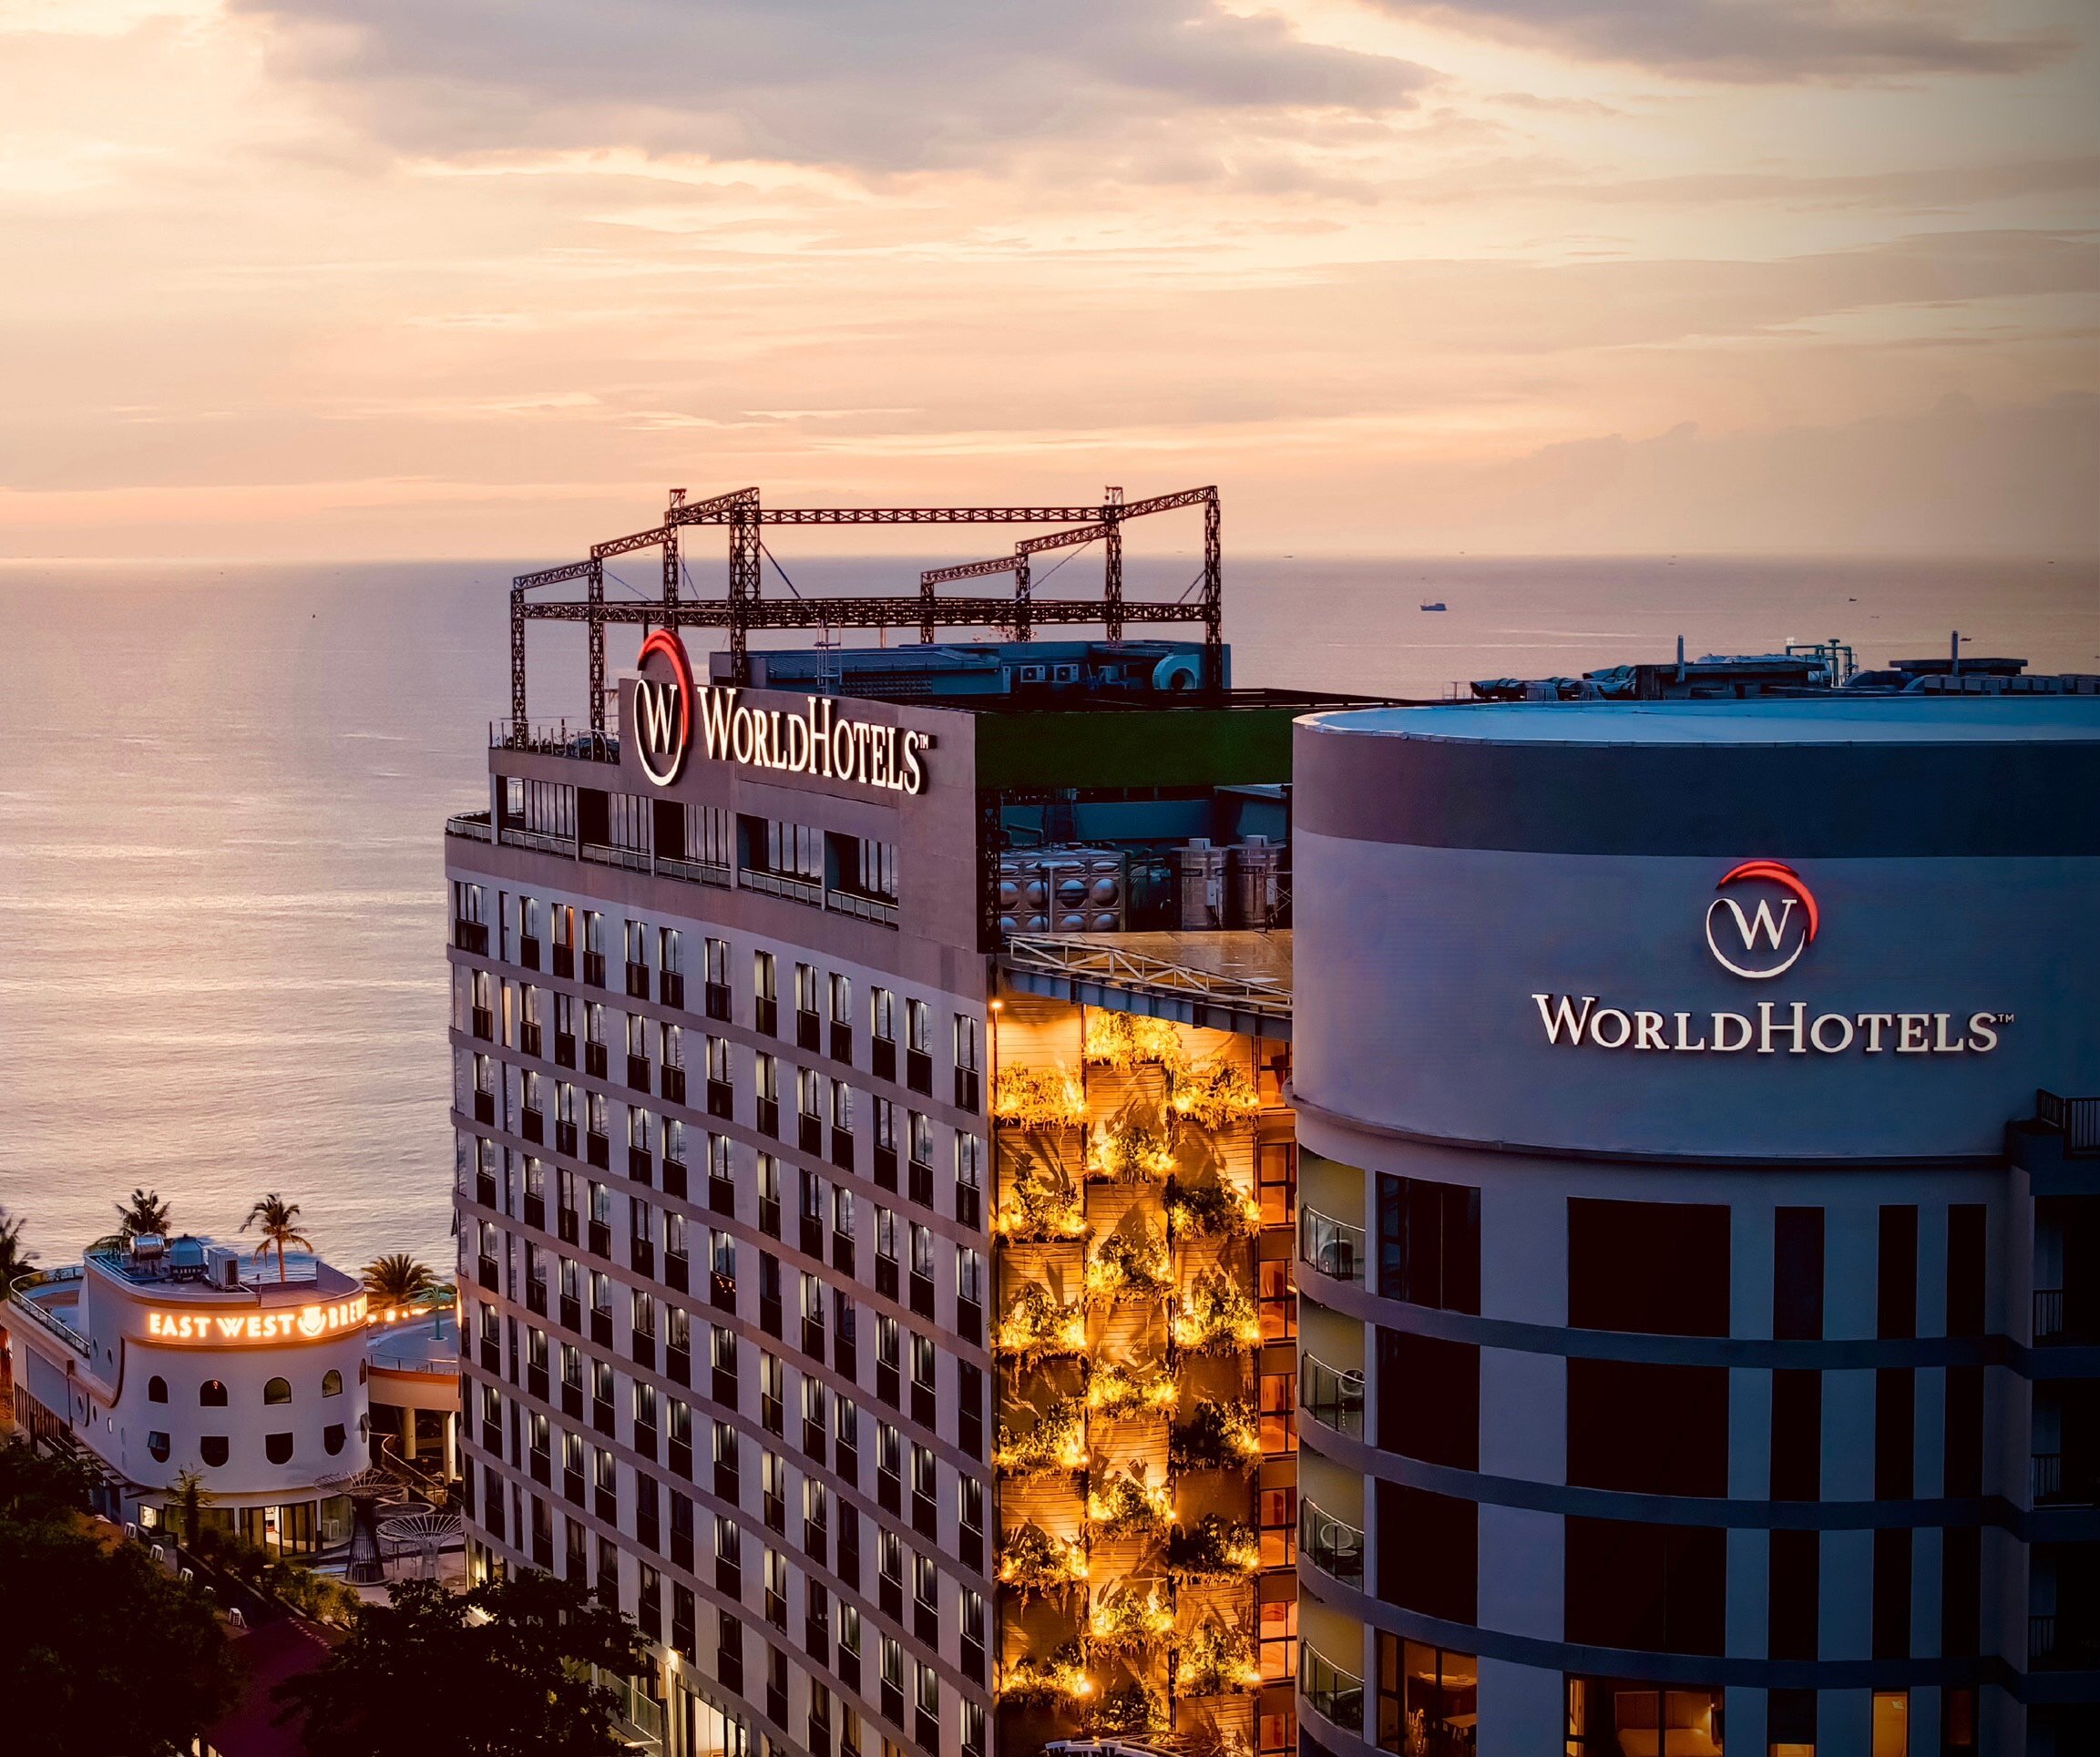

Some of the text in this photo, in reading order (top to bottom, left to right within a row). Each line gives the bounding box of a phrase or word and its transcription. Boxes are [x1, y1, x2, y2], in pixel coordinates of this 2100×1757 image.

[1718, 898, 1798, 950] W
[149, 1313, 211, 1338] EAST
[215, 1313, 295, 1338] WEST
